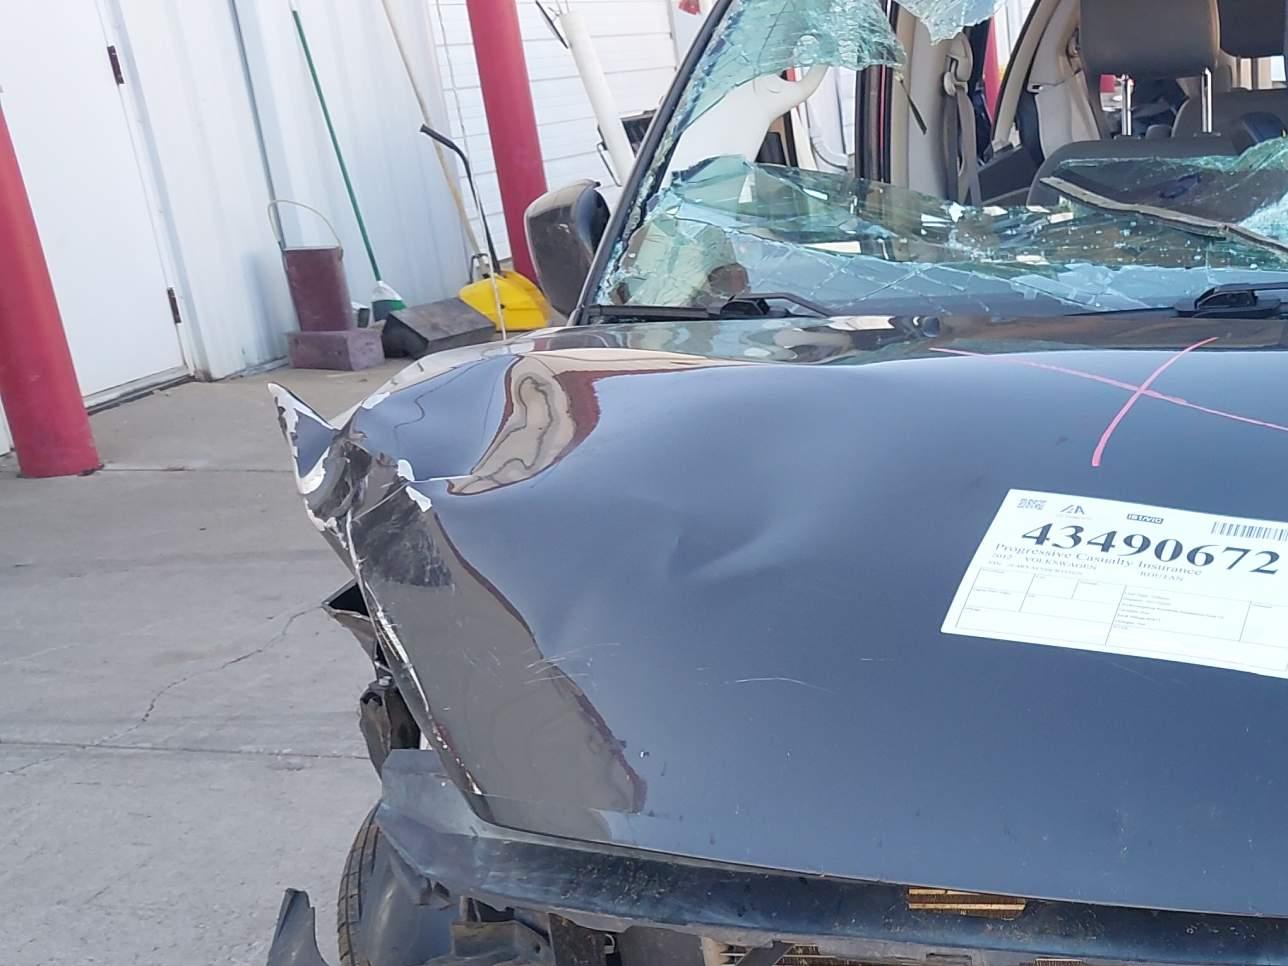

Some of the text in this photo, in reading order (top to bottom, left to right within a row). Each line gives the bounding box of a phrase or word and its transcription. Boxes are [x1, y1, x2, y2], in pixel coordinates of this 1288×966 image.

[995, 543, 1072, 559] Progressive
[1076, 552, 1132, 568] Casualty
[1138, 558, 1202, 576] Insurance
[1021, 523, 1280, 575] 43490672
[1025, 556, 1097, 570] VOLKSWAGEN
